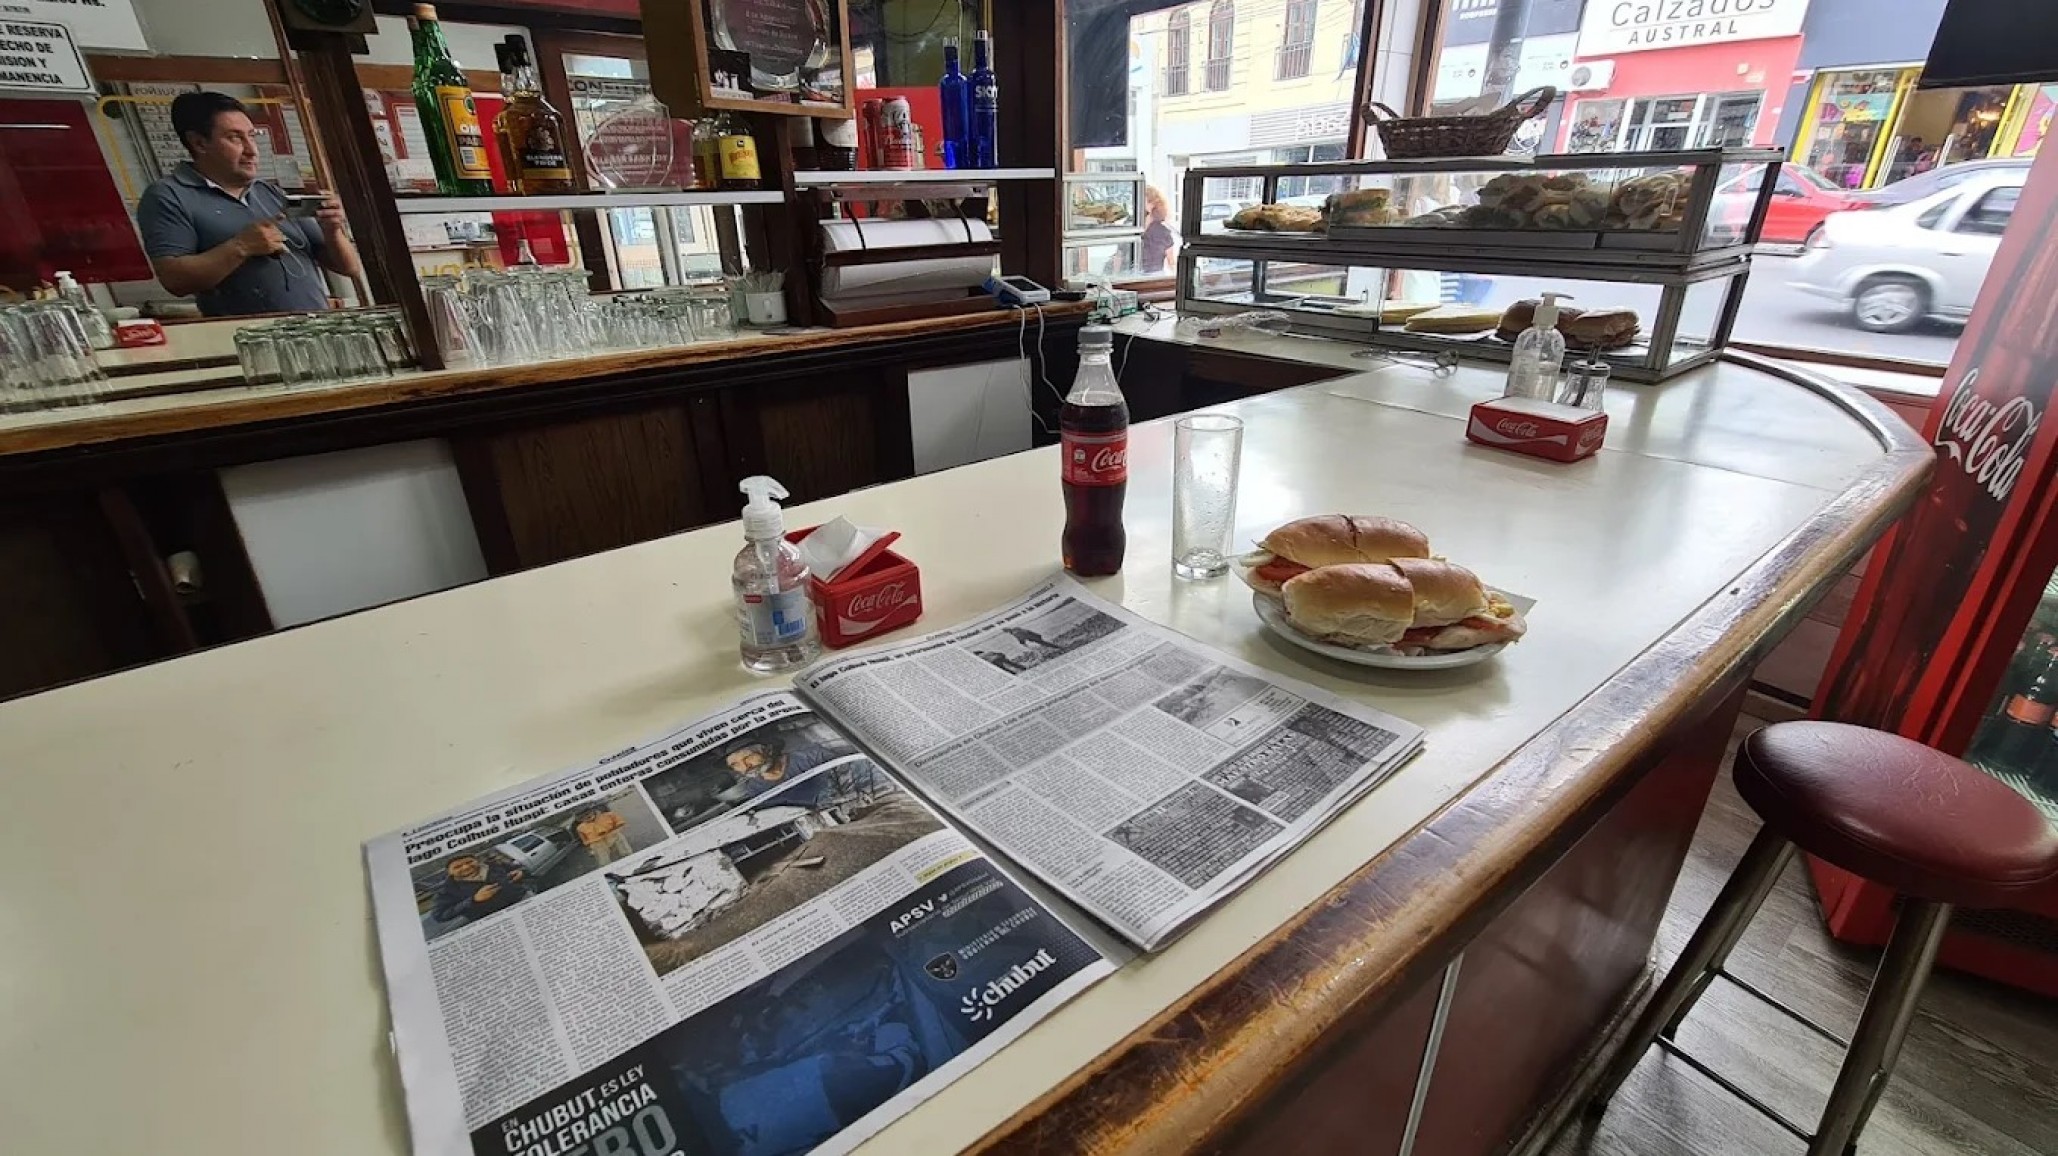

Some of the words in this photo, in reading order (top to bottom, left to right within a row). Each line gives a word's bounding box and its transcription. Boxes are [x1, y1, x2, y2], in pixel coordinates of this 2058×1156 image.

[5, 24, 63, 39] RESERVA
[35, 42, 54, 54] DE
[1628, 19, 1738, 45] AUSTRAL
[38, 57, 47, 69] Y
[404, 818, 482, 854] Preocupa
[485, 813, 502, 825] la
[505, 786, 572, 818] situación
[574, 778, 593, 791] de
[595, 749, 669, 785] pobladores
[671, 736, 695, 752] que
[695, 719, 731, 740] viven
[730, 706, 766, 725] cerca
[766, 699, 785, 710] del
[406, 847, 443, 867] lago
[446, 824, 502, 851] Colhué
[503, 806, 550, 831] Huapi:
[552, 788, 597, 811] casas
[598, 766, 654, 793] enteras
[656, 731, 730, 769] consumidas
[730, 721, 752, 736] por
[753, 713, 767, 724] la
[888, 898, 936, 934] APSV
[981, 946, 1058, 1006] chubut
[601, 1081, 619, 1098] ES
[618, 1063, 645, 1088] LEY
[501, 1116, 520, 1133] EN
[512, 1082, 658, 1156] OLERANCIA
